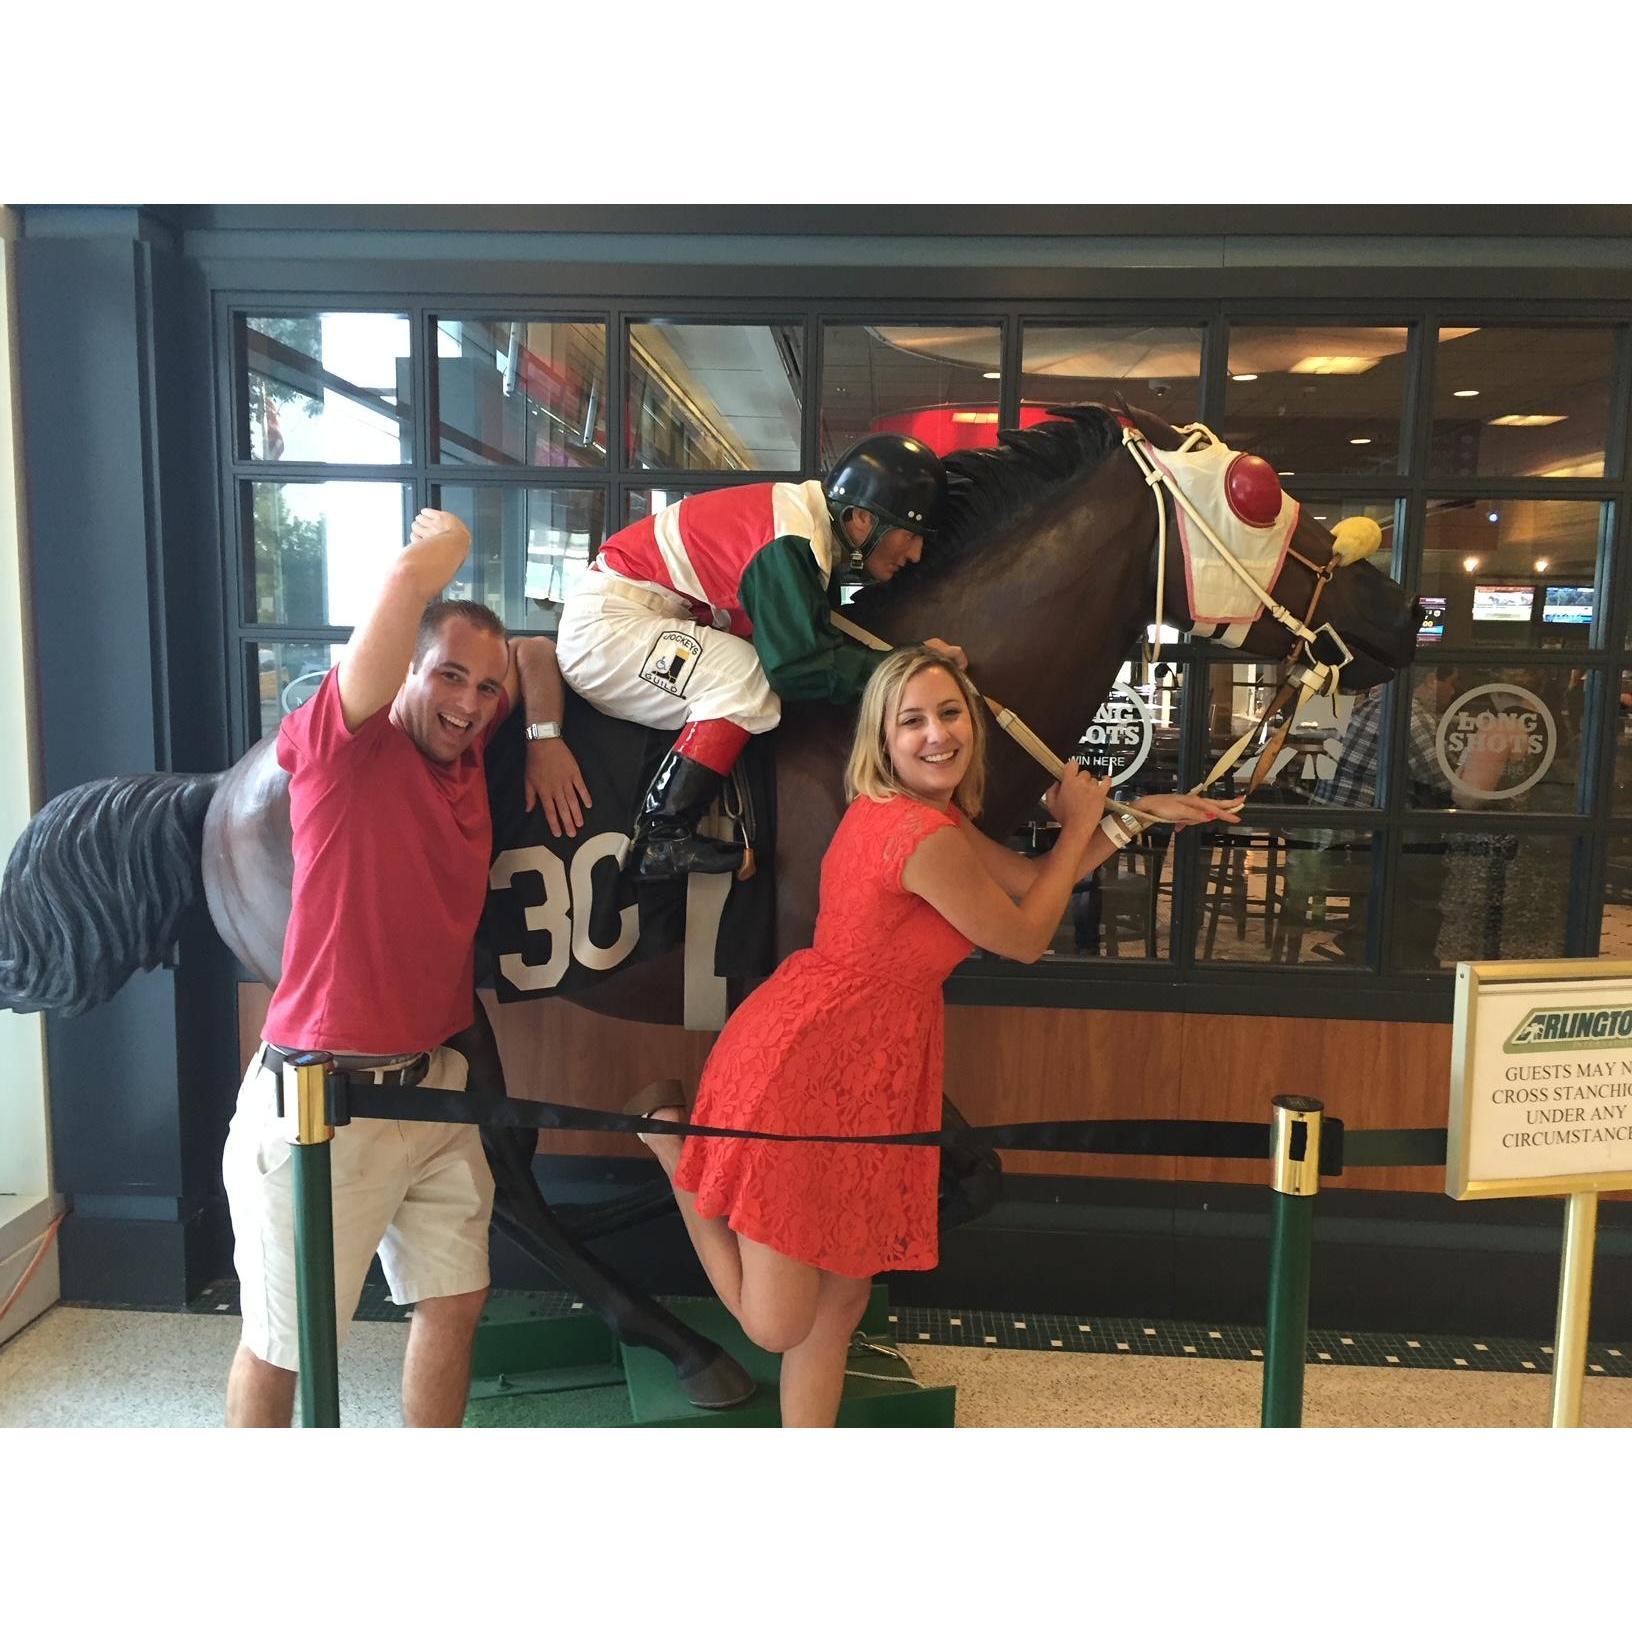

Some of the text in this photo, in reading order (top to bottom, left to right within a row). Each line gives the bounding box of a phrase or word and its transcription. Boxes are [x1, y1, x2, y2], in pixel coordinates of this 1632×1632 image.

[663, 634, 699, 655] JOCKEYS
[645, 673, 678, 693] GUILD
[1091, 702, 1134, 723] NG
[1457, 711, 1538, 732] LONG
[1079, 725, 1140, 745] OTS
[1448, 732, 1544, 754] SHOTS
[1093, 756, 1126, 767] HERE
[1515, 1010, 1632, 1042] ARLINGTO
[1505, 1064, 1572, 1082] GUESTS
[1577, 1062, 1616, 1078] MAY
[1492, 1087, 1549, 1104] CROSS
[1527, 1105, 1627, 1124] UNDER ANY
